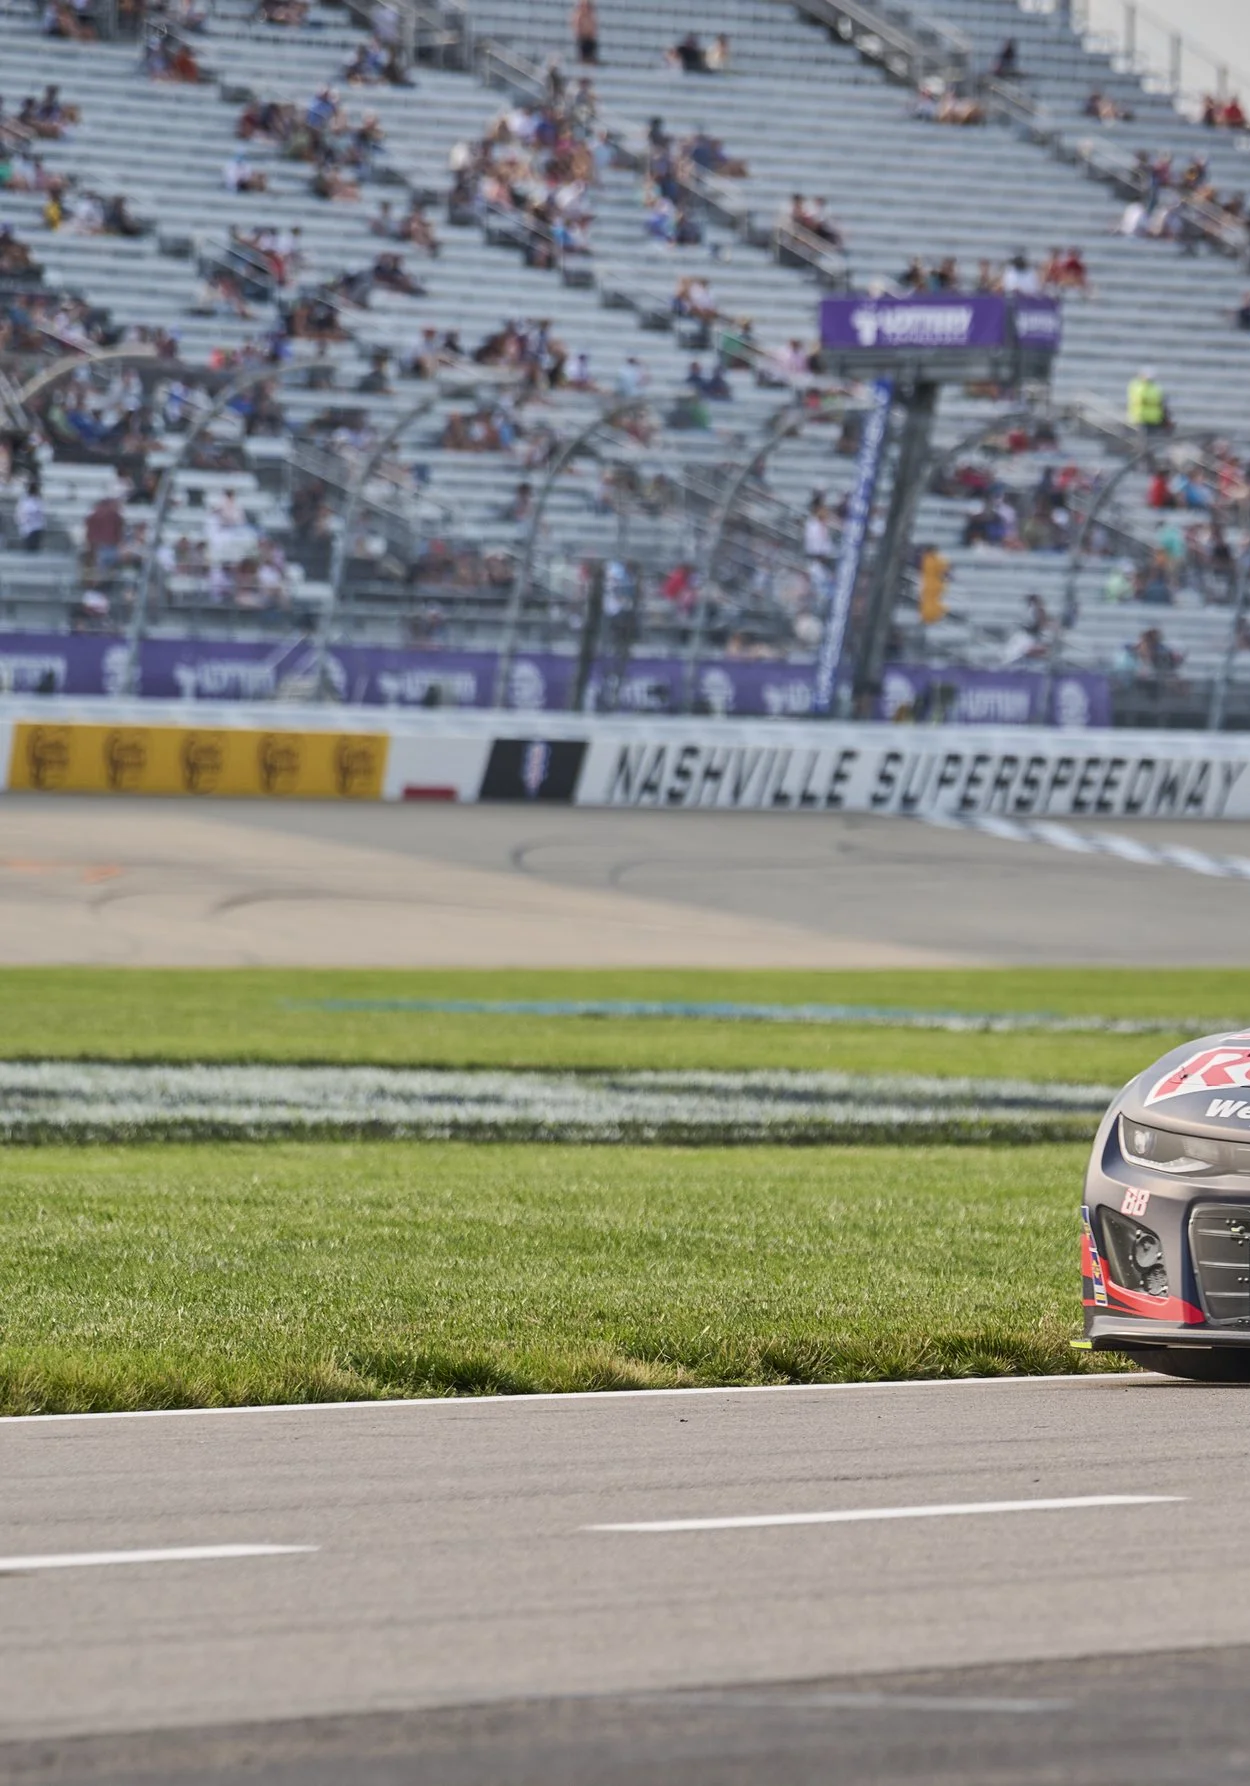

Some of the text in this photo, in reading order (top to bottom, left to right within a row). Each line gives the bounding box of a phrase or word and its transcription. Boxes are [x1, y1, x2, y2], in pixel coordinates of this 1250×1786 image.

[607, 742, 1246, 817] NASHVILLE SUPERSPEEDWAY
[1121, 1187, 1150, 1216] 88
